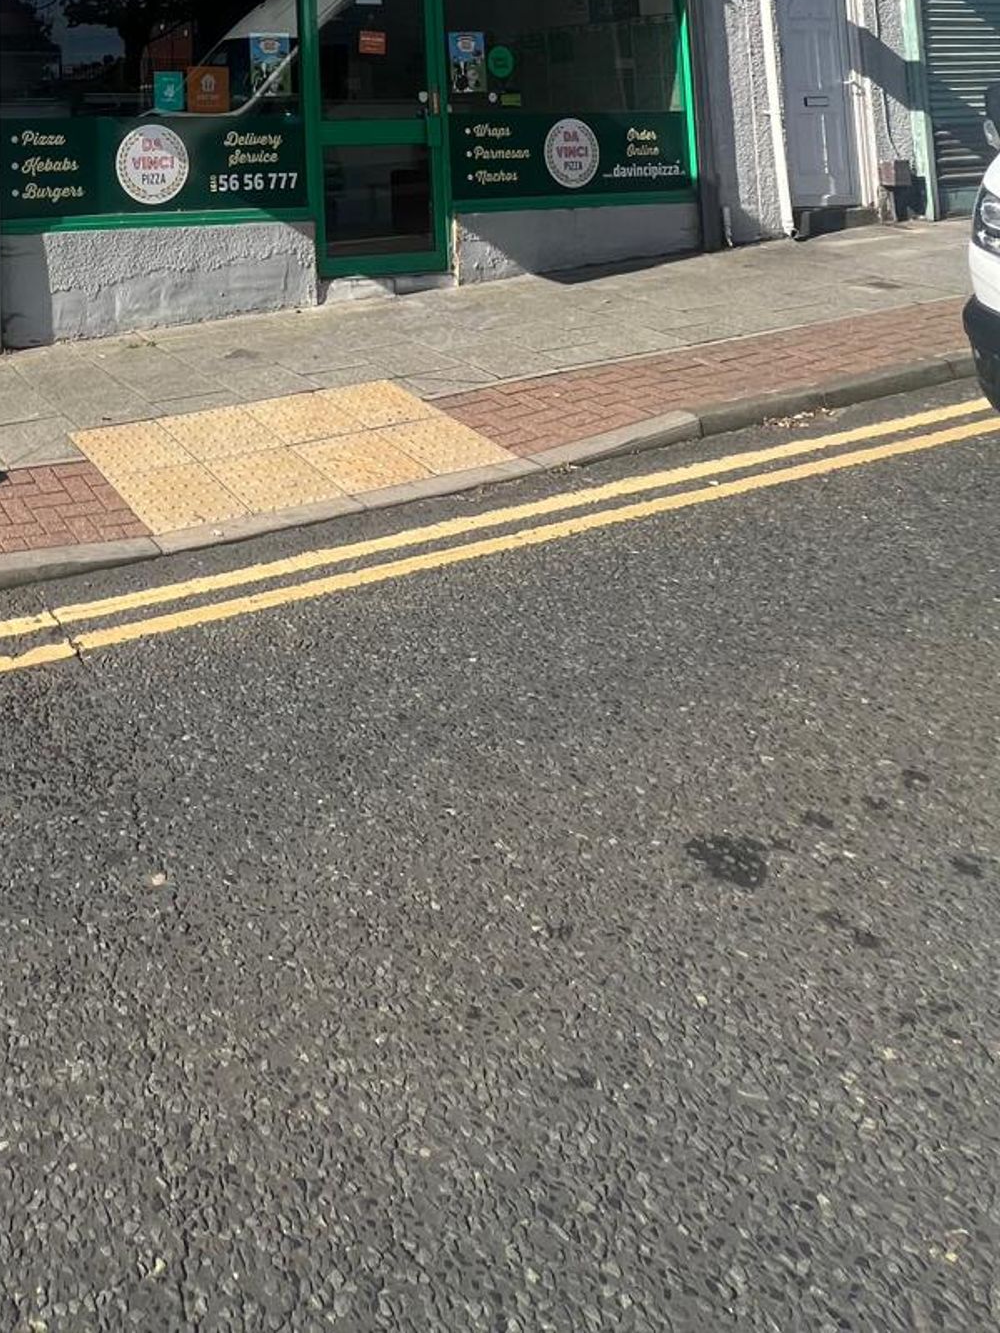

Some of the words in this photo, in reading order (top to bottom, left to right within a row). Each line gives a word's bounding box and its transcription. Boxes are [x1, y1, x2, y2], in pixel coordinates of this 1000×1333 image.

[21, 130, 66, 146] Pizza
[223, 131, 283, 150] Delivery
[563, 130, 579, 143] DA
[228, 149, 279, 168] Service
[473, 145, 531, 160] Parmesan
[556, 146, 588, 159] VINCI
[21, 156, 80, 177] Kebabs
[141, 173, 167, 185] PIZZA
[218, 174, 240, 192] 56
[243, 172, 265, 191] 56
[267, 172, 298, 190] 777
[22, 182, 86, 203] Burgers
